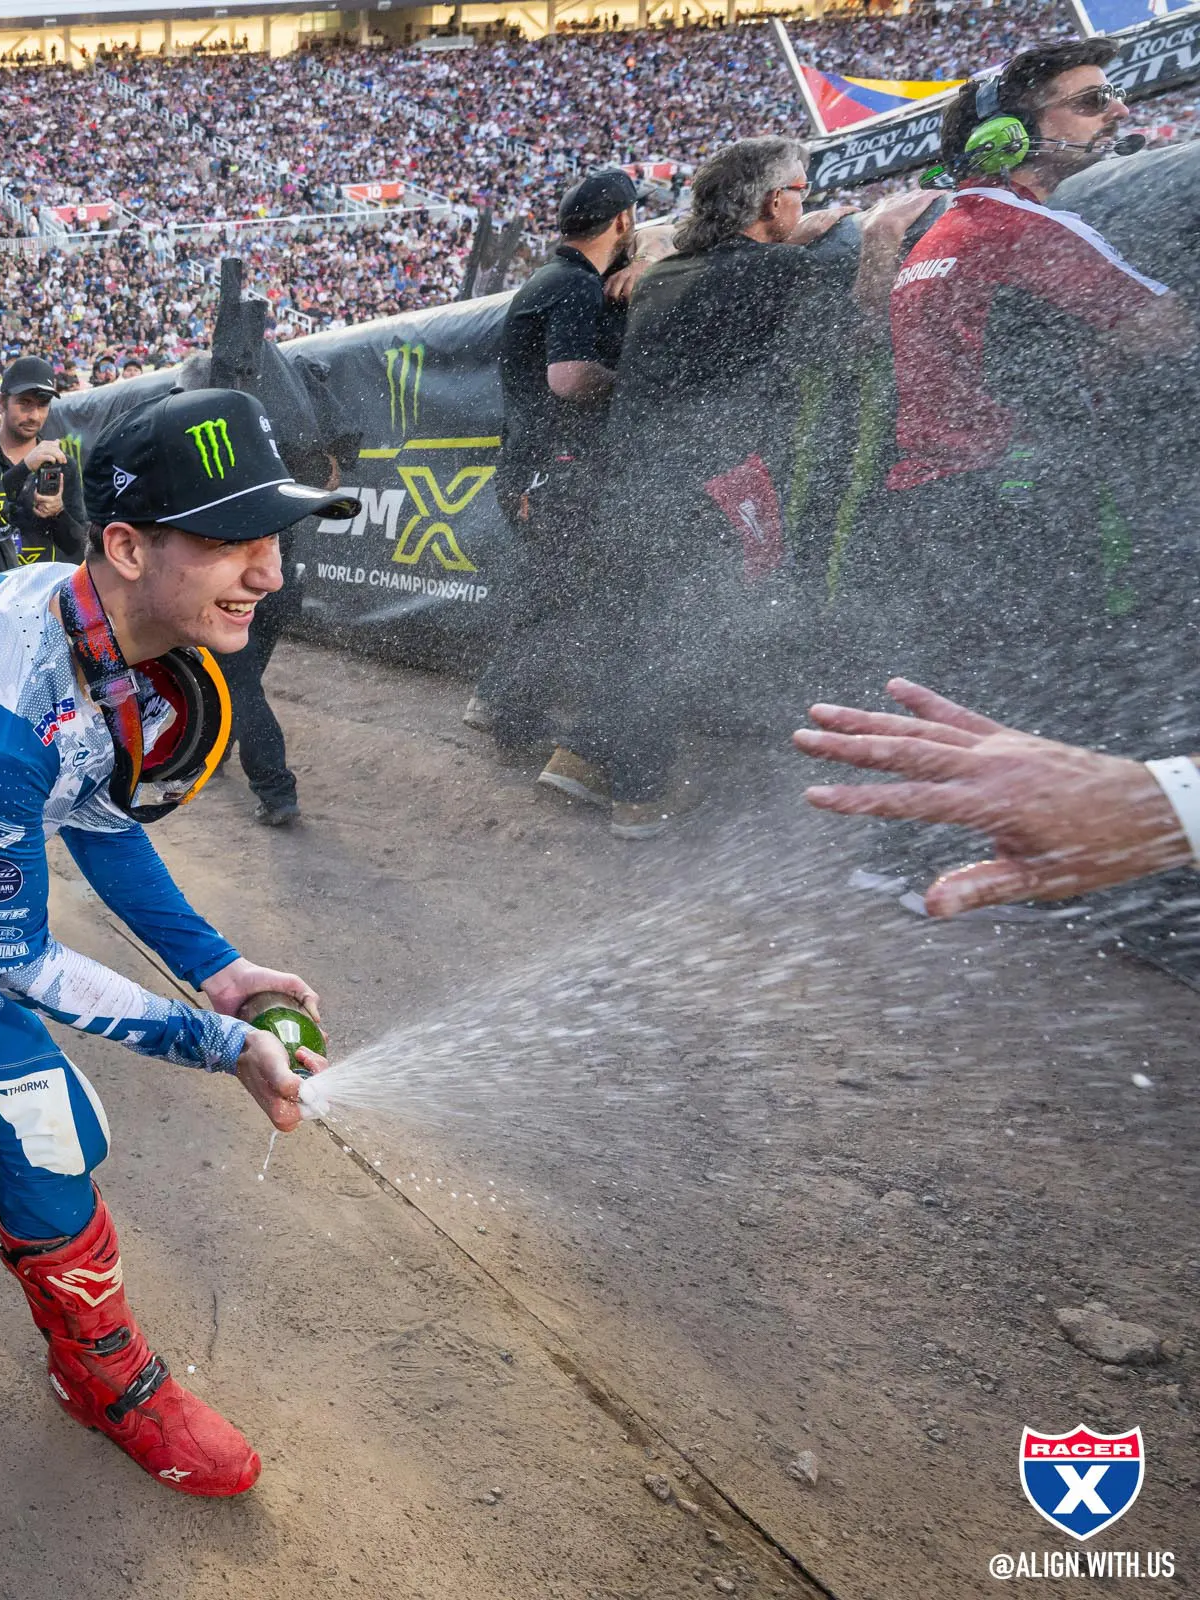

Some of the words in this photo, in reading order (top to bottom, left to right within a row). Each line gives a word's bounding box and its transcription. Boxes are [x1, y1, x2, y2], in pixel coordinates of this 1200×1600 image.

[843, 128, 902, 158] ROCKY
[894, 257, 957, 290] SHOWA
[318, 562, 365, 585] WORLD
[369, 569, 488, 603] CHAMPIONSHIP
